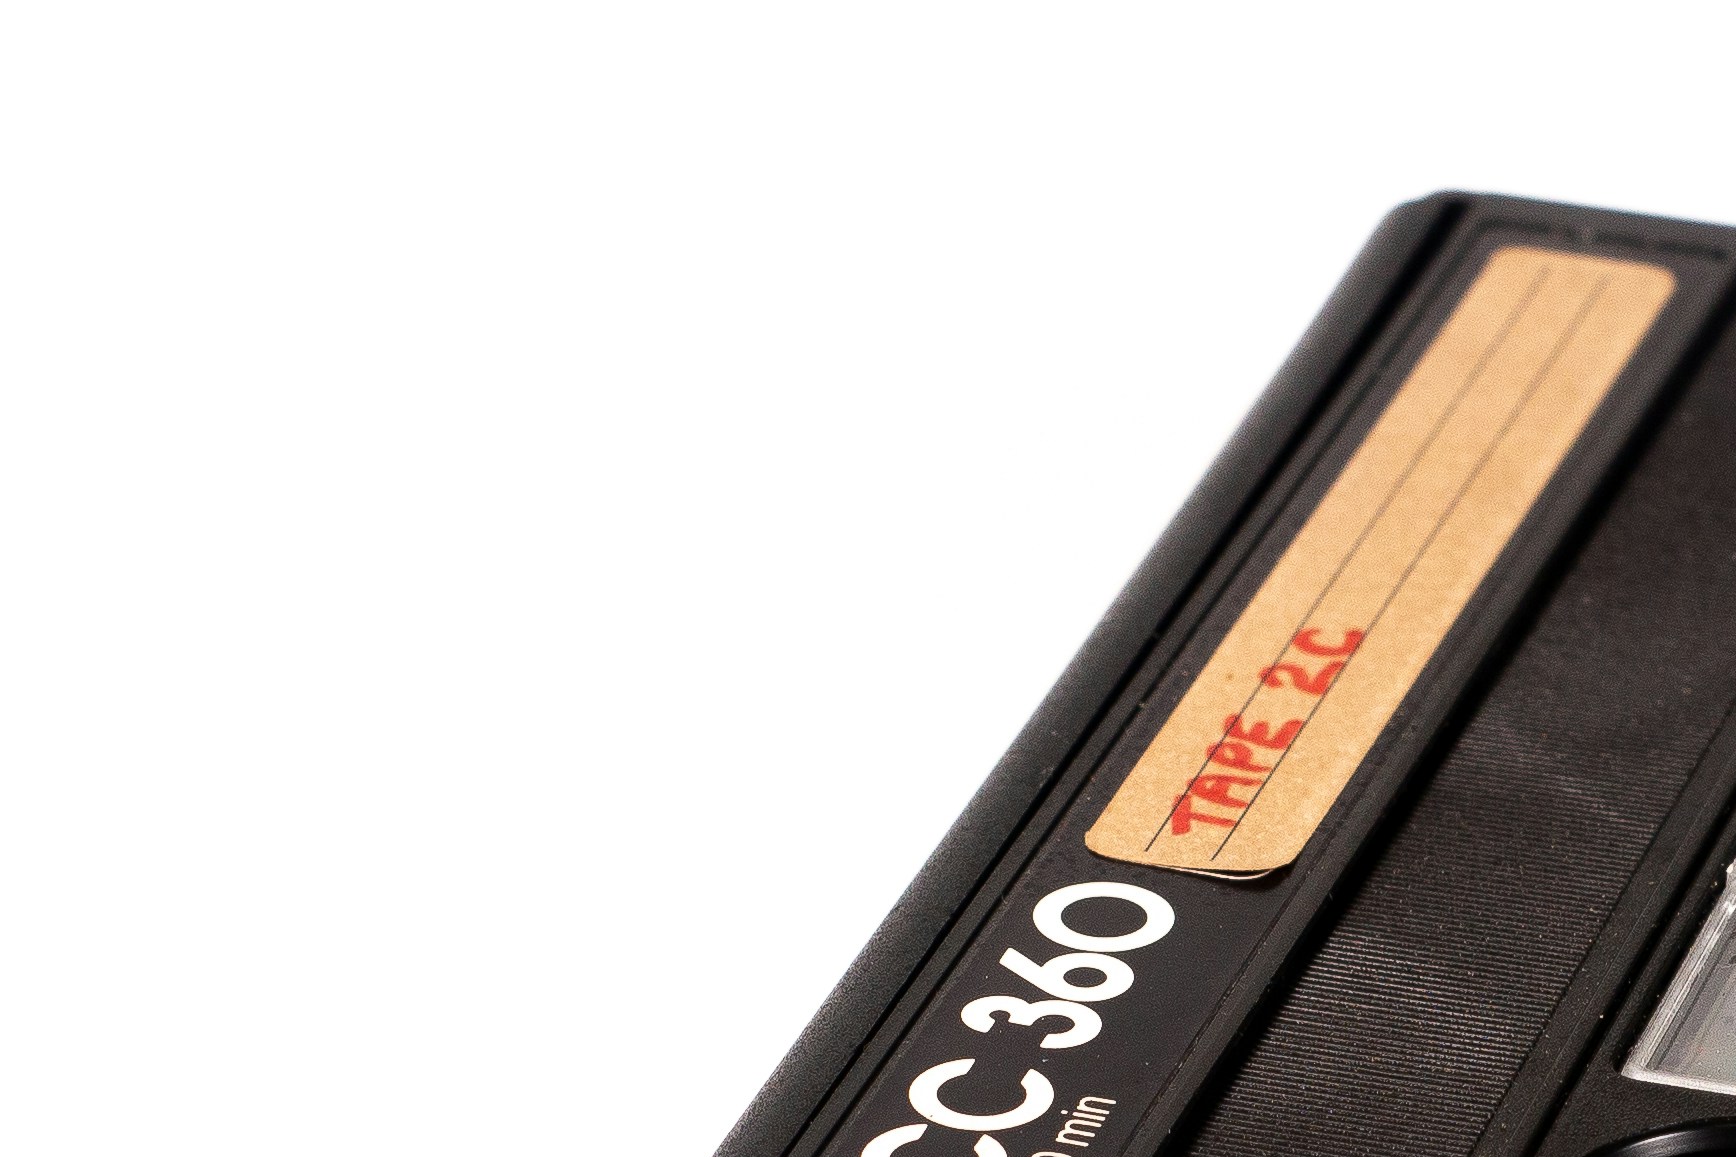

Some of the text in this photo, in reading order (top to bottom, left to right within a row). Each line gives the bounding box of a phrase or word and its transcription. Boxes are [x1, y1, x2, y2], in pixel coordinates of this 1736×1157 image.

[1171, 627, 1366, 836] TAPE 2C
[961, 881, 1176, 1050] 360
[1055, 1096, 1117, 1147] min
